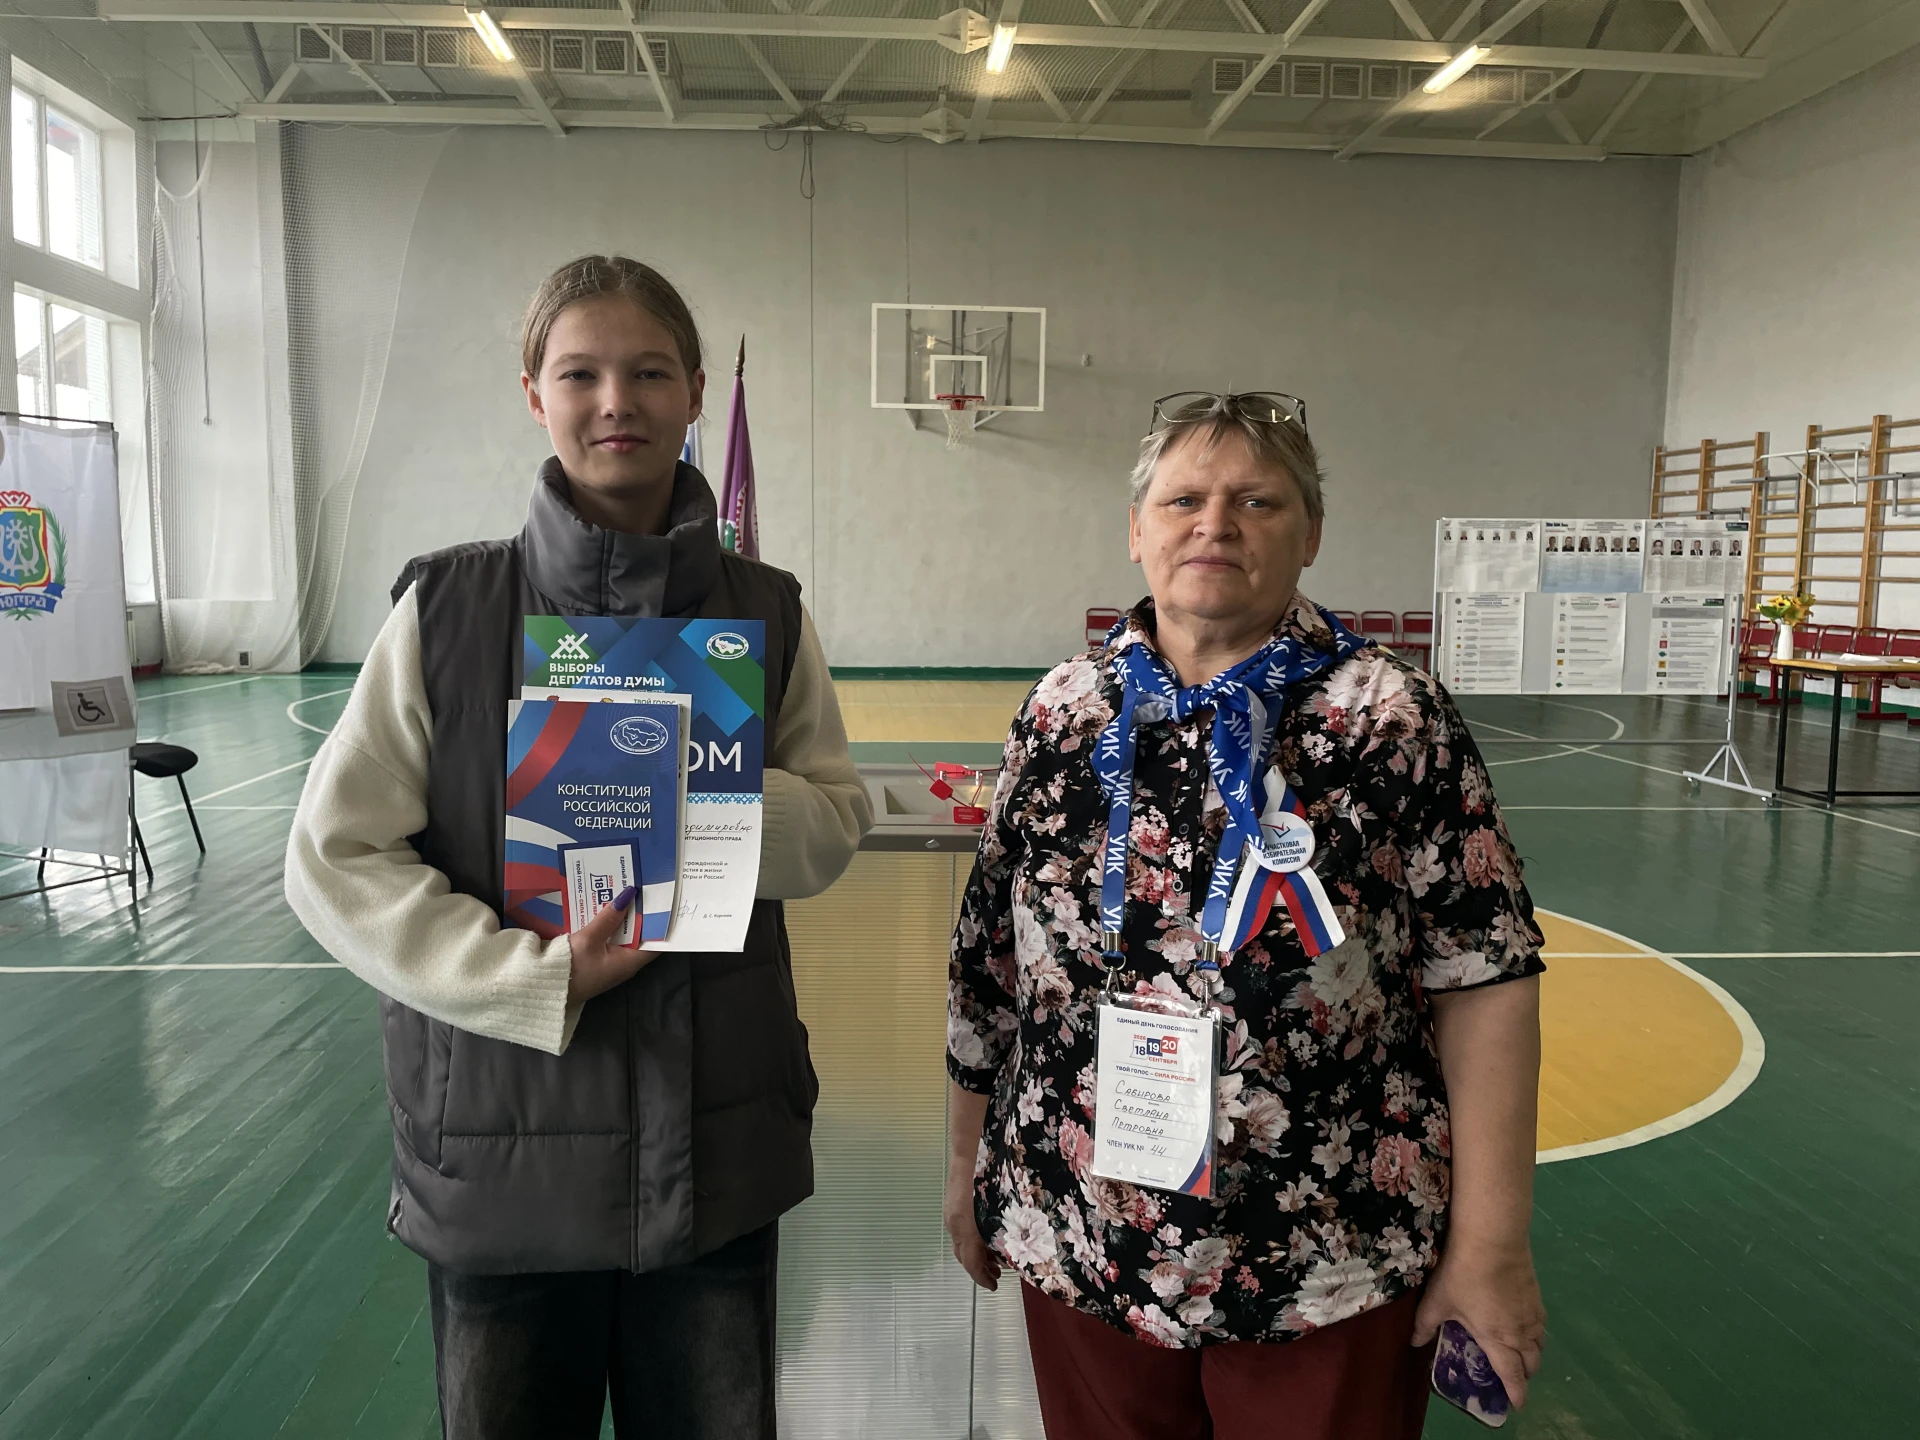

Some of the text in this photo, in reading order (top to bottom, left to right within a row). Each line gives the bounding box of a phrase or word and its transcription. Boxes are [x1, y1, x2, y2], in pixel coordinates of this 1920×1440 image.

[549, 663, 605, 673] ВЫБОРЫ
[549, 675, 665, 688] ДЕПУТАТОВ ДУМЫ
[557, 784, 651, 798] КОНСТИТУЦИЯ
[563, 800, 651, 813] РОССИЙСКОЙ
[574, 816, 652, 830] ФЕДЕРАЦИИ
[1106, 834, 1126, 875] УИК
[1263, 847, 1307, 859] ИЗБИРАТЕЛЬНАЯ
[620, 856, 628, 879] ЕДИНЫЙ
[1272, 855, 1301, 866] КОМИССИЯ
[1208, 857, 1236, 899] УИК
[595, 878, 610, 902] 18 19
[1116, 1017, 1140, 1026] ЕДИНЫЙ
[1156, 1023, 1198, 1034] ГОЛОСОВАНИЯ
[1135, 1040, 1177, 1056] 18 19 20
[1148, 1057, 1178, 1065] СЕНТЯБРЯ
[1106, 1139, 1123, 1148] ЧЛЕН
[1123, 1142, 1135, 1150] УИК
